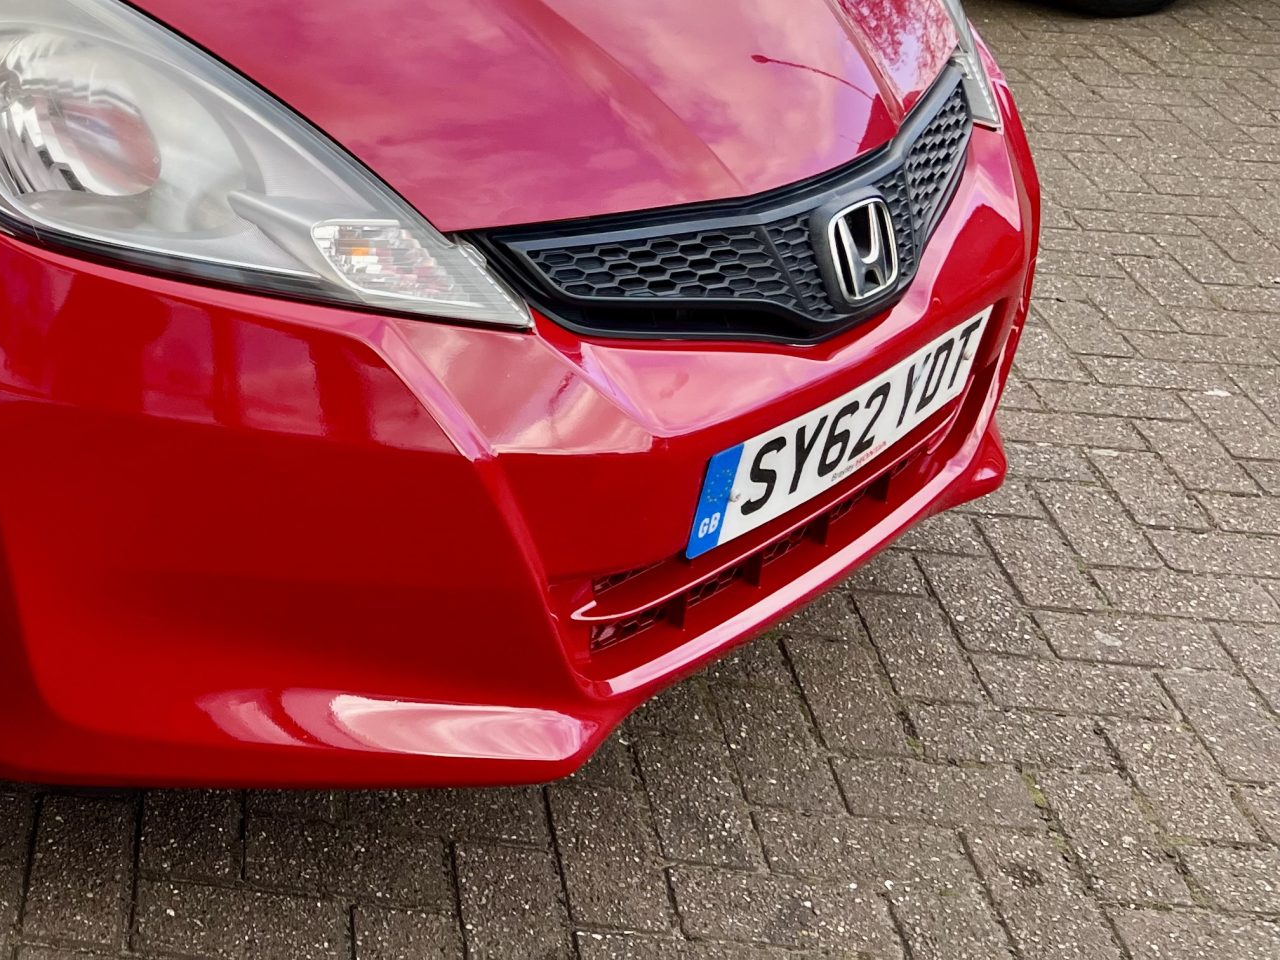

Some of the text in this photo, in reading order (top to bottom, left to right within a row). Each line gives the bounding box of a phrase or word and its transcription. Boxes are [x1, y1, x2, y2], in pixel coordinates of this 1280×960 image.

[740, 316, 983, 516] SY62 YDT
[697, 511, 721, 539] GB
